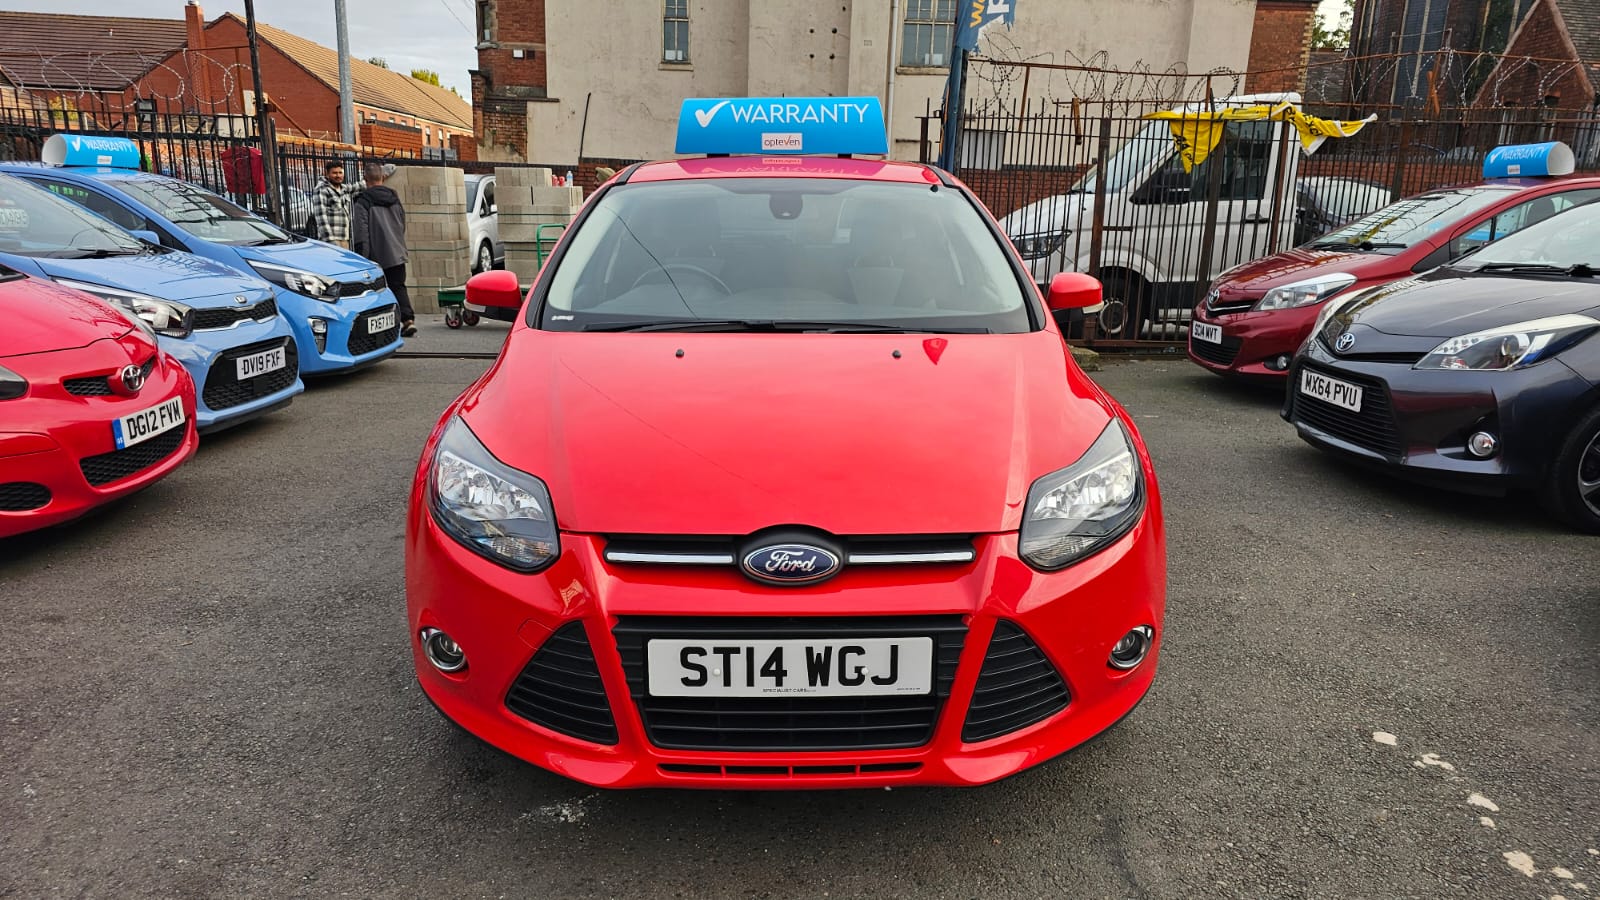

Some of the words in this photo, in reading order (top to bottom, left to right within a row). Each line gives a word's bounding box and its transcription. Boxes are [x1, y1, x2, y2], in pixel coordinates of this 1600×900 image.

[730, 103, 870, 124] WARRANTY
[82, 138, 133, 152] WARRANTY
[764, 135, 801, 147] opteven
[1501, 146, 1546, 160] WARRANTY
[242, 355, 264, 375] DV19
[265, 350, 281, 369] FXF
[1305, 372, 1331, 398] MX64
[1333, 383, 1358, 407] PVU
[126, 410, 159, 440] DG12
[159, 399, 181, 428] FVM
[765, 550, 817, 572] Ford
[679, 646, 788, 687] ST14
[805, 644, 899, 687] WGJ
